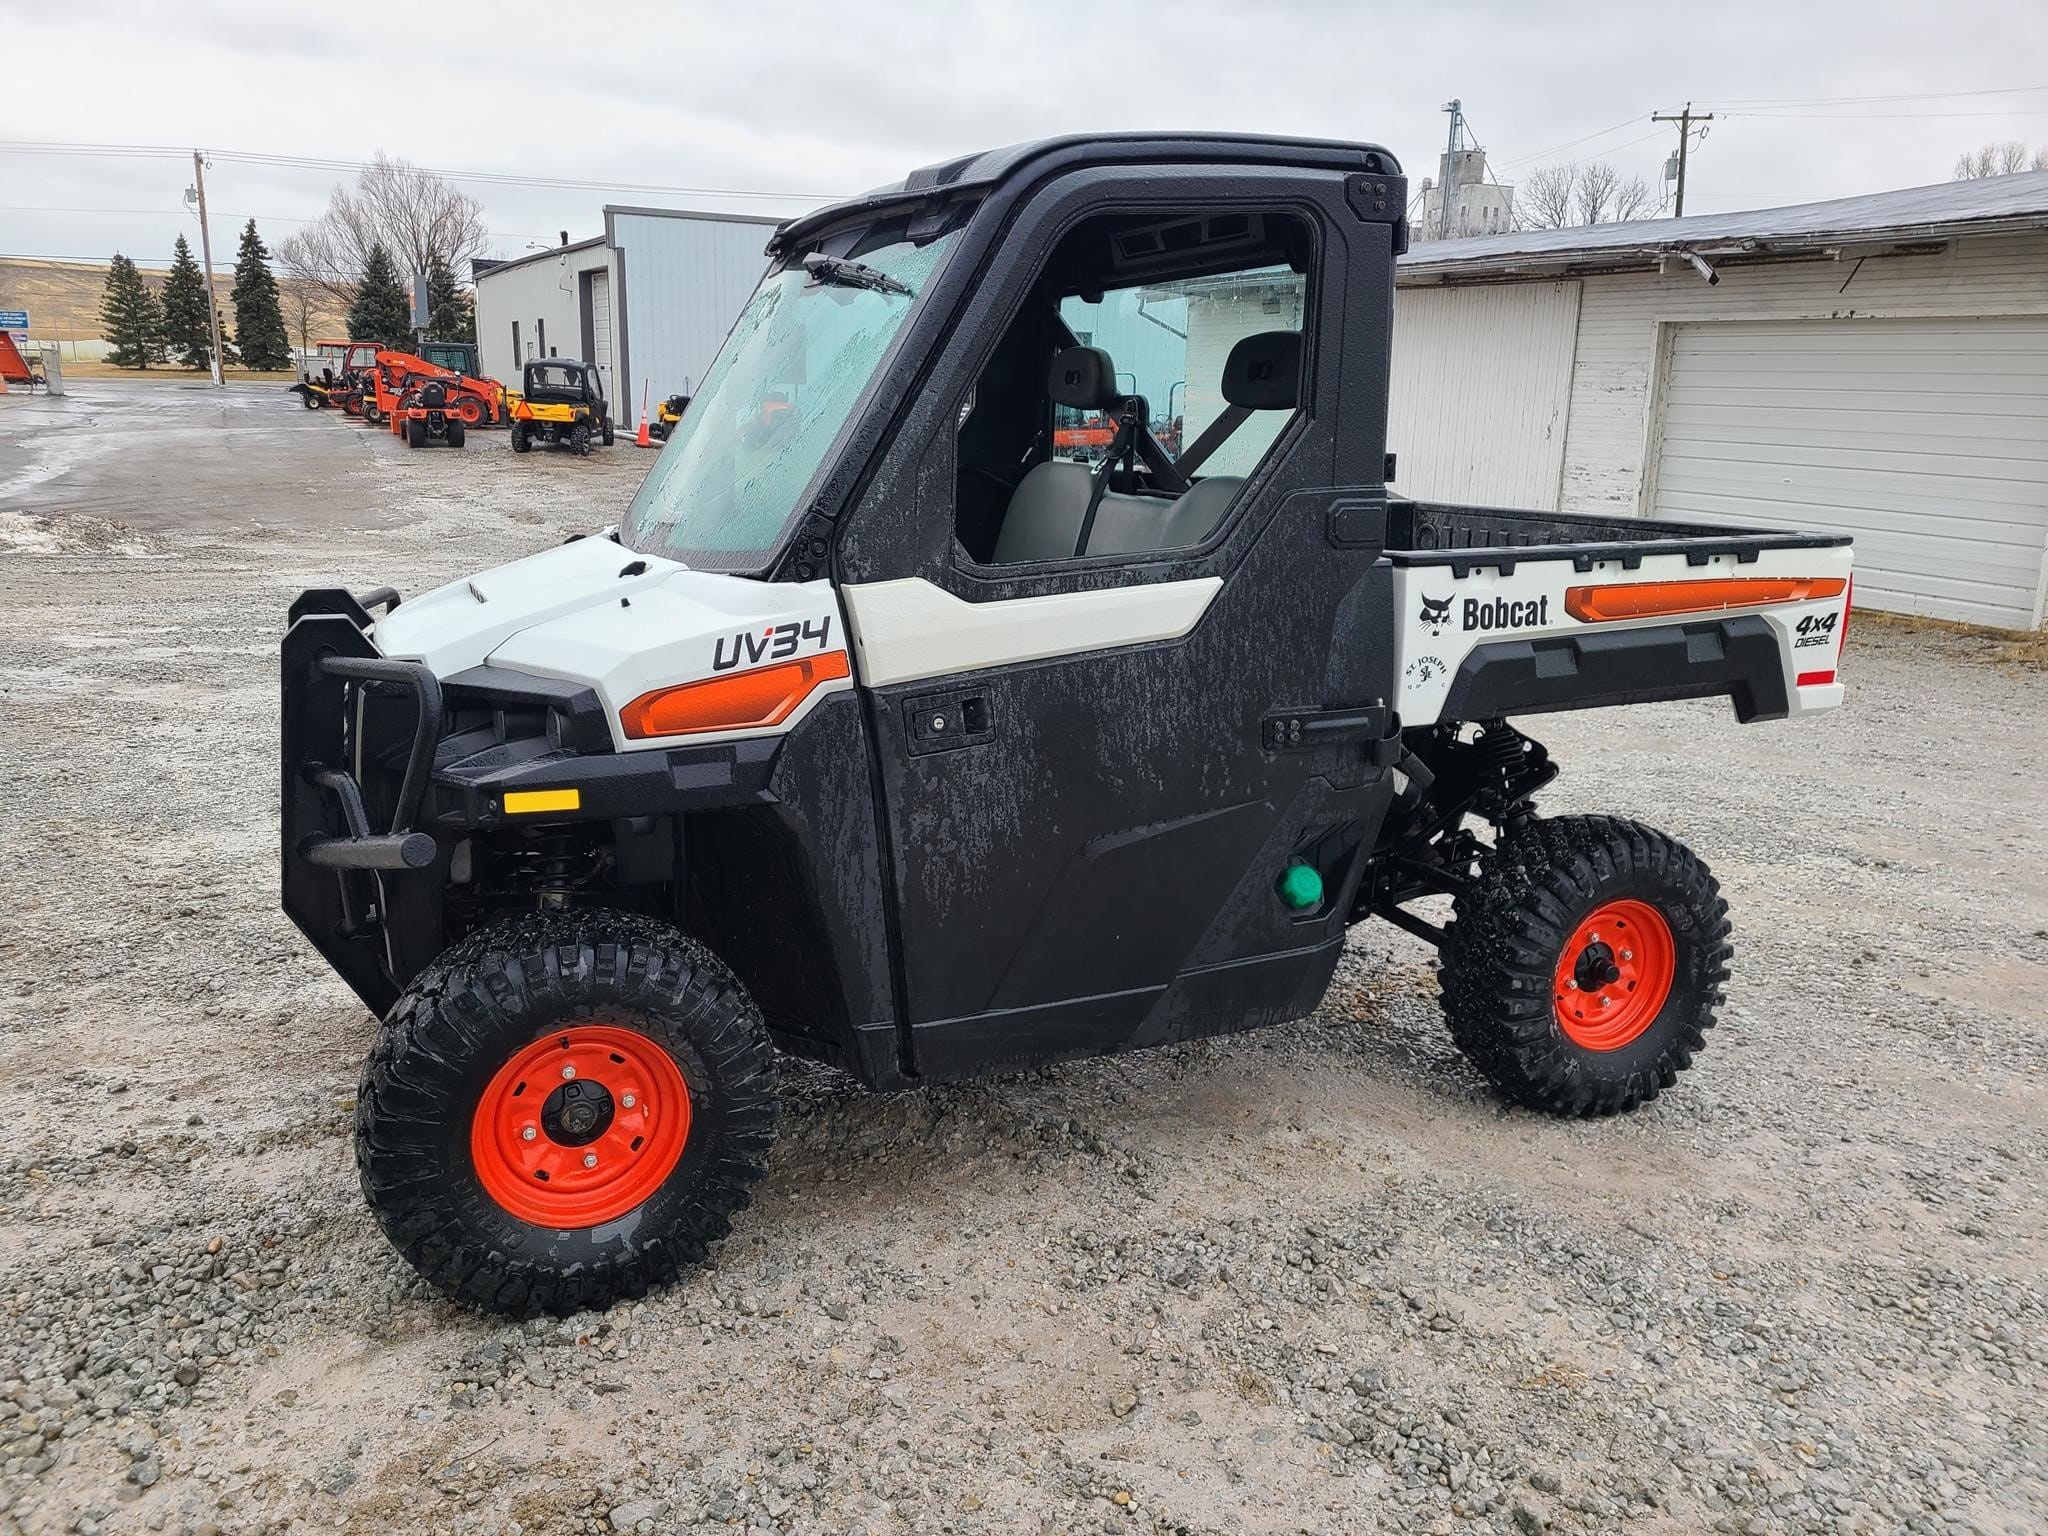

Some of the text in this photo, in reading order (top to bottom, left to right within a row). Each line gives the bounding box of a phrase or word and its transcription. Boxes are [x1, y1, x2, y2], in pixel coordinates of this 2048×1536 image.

[1463, 595, 1548, 631] Bobcat
[1796, 612, 1839, 636] 4x4
[712, 616, 831, 671] UV34
[1794, 635, 1830, 648] DIESEL
[1418, 656, 1447, 674] JOSEPH
